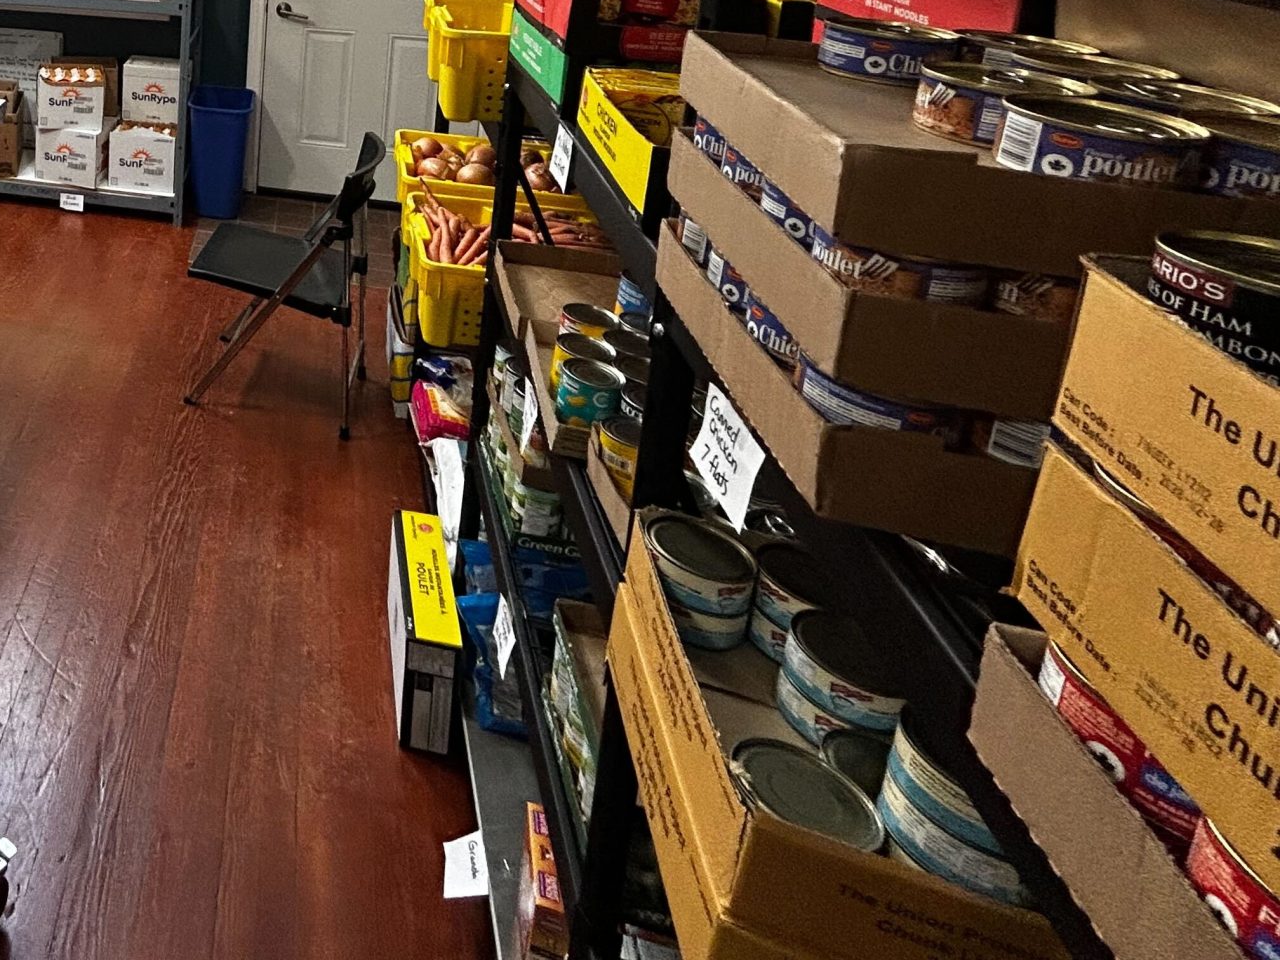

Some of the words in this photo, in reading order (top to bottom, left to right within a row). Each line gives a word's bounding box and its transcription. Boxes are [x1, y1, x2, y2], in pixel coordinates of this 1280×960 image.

[894, 6, 929, 26] NOODLES
[131, 92, 177, 106] SunRype
[1161, 289, 1185, 309] OF
[1189, 300, 1253, 336] HAM
[759, 325, 798, 359] Chic
[1063, 387, 1081, 404] Can
[709, 395, 740, 448] Canned
[1059, 403, 1081, 427] Best
[1081, 421, 1115, 457] Before
[1189, 384, 1242, 445] The
[701, 443, 711, 460] 7
[709, 417, 738, 474] Chicken
[517, 537, 561, 558] Green
[415, 562, 430, 596] POULET
[1028, 559, 1050, 585] Can
[1025, 576, 1048, 603] Best
[1047, 600, 1084, 642] Before
[1157, 587, 1213, 661] The
[1222, 651, 1280, 727] Uni
